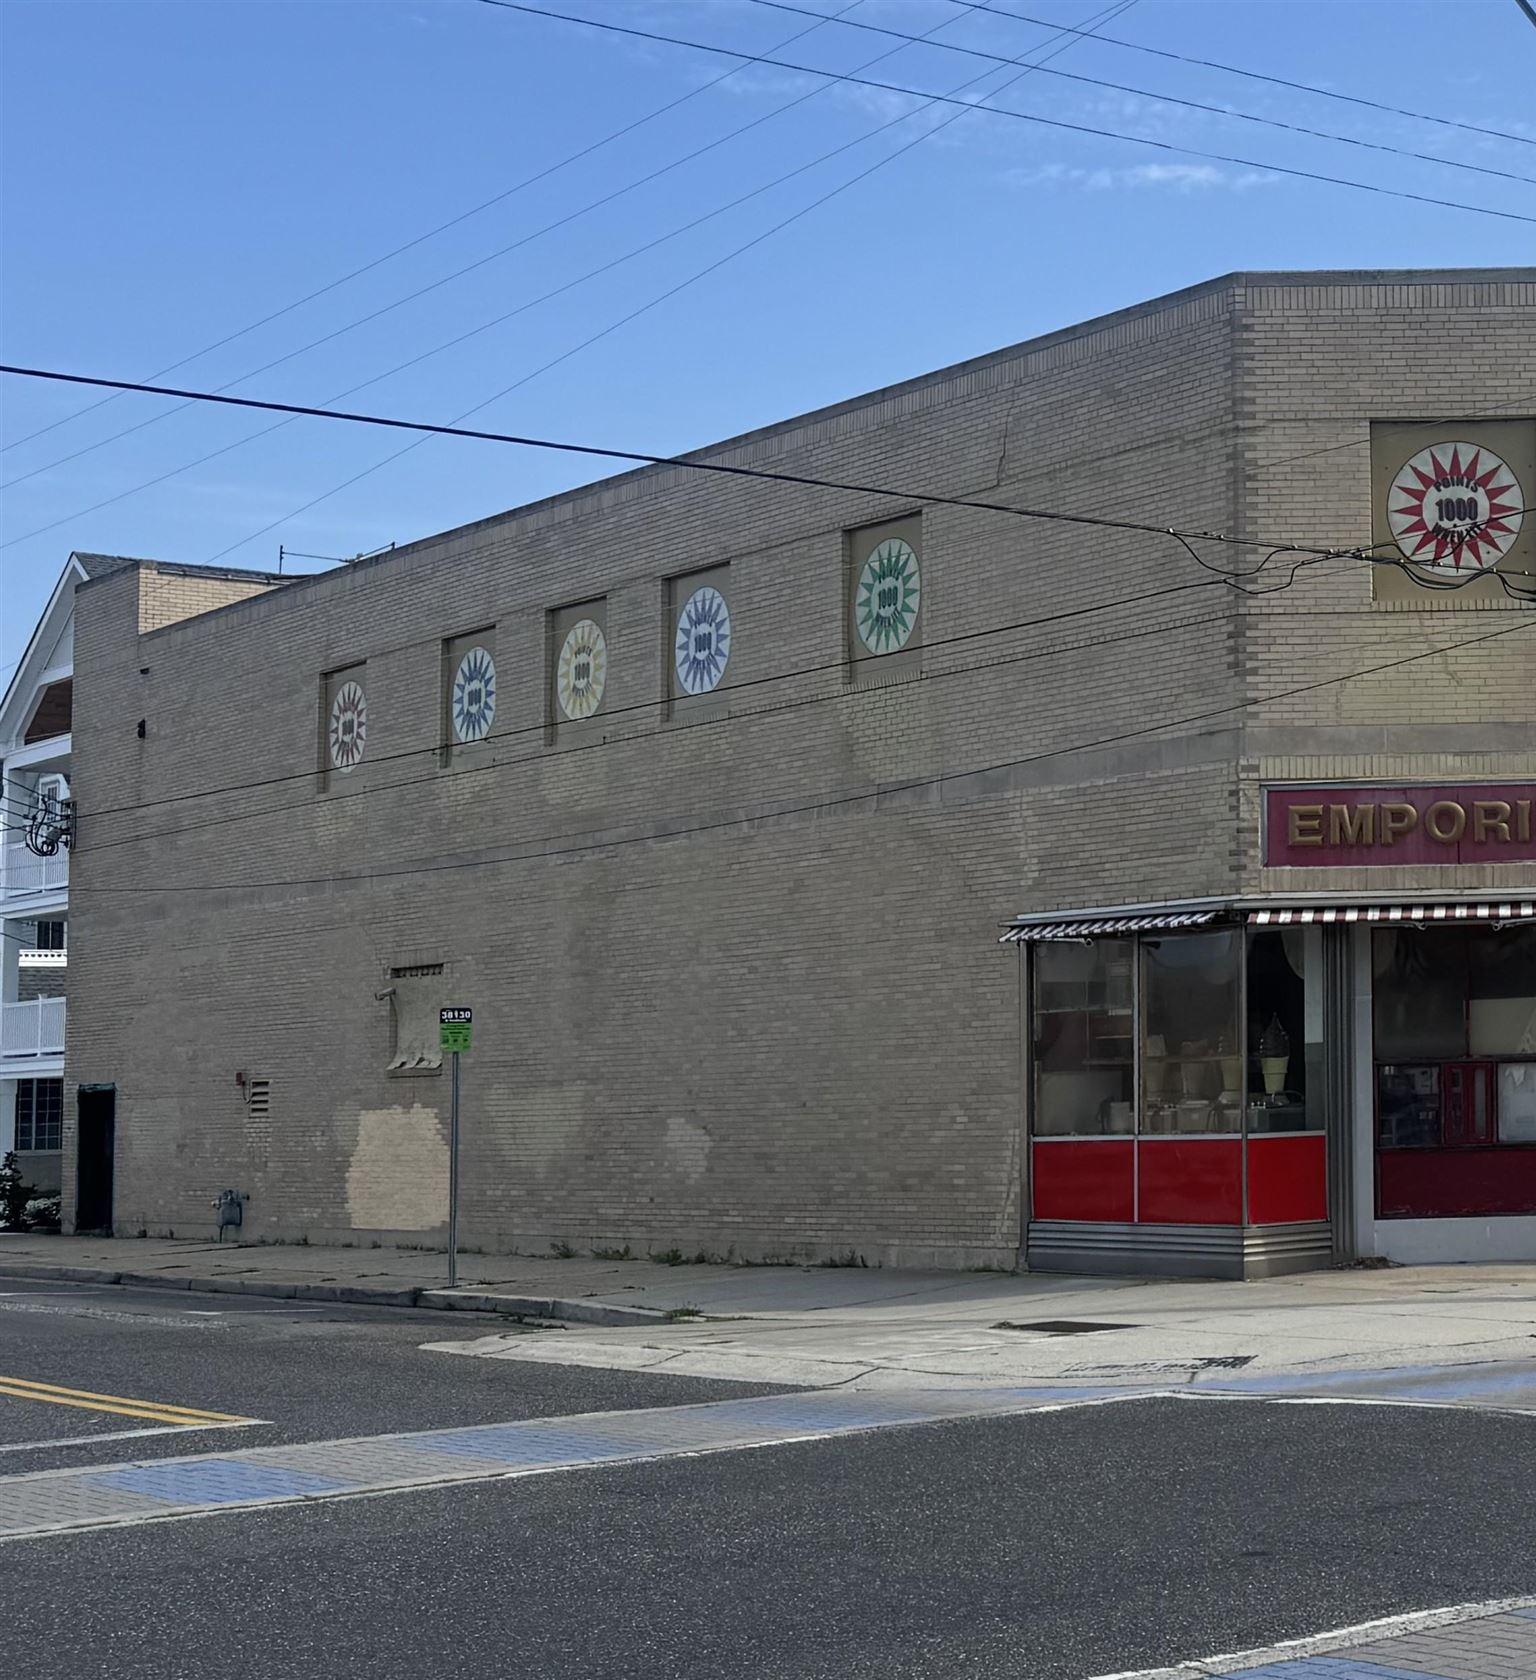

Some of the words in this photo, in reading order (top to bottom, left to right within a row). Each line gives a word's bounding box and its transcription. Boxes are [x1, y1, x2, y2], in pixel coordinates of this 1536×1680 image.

[1434, 476, 1479, 493] POINTS
[1435, 497, 1479, 521] 1000
[878, 585, 898, 609] 1000
[574, 661, 591, 681] 1000
